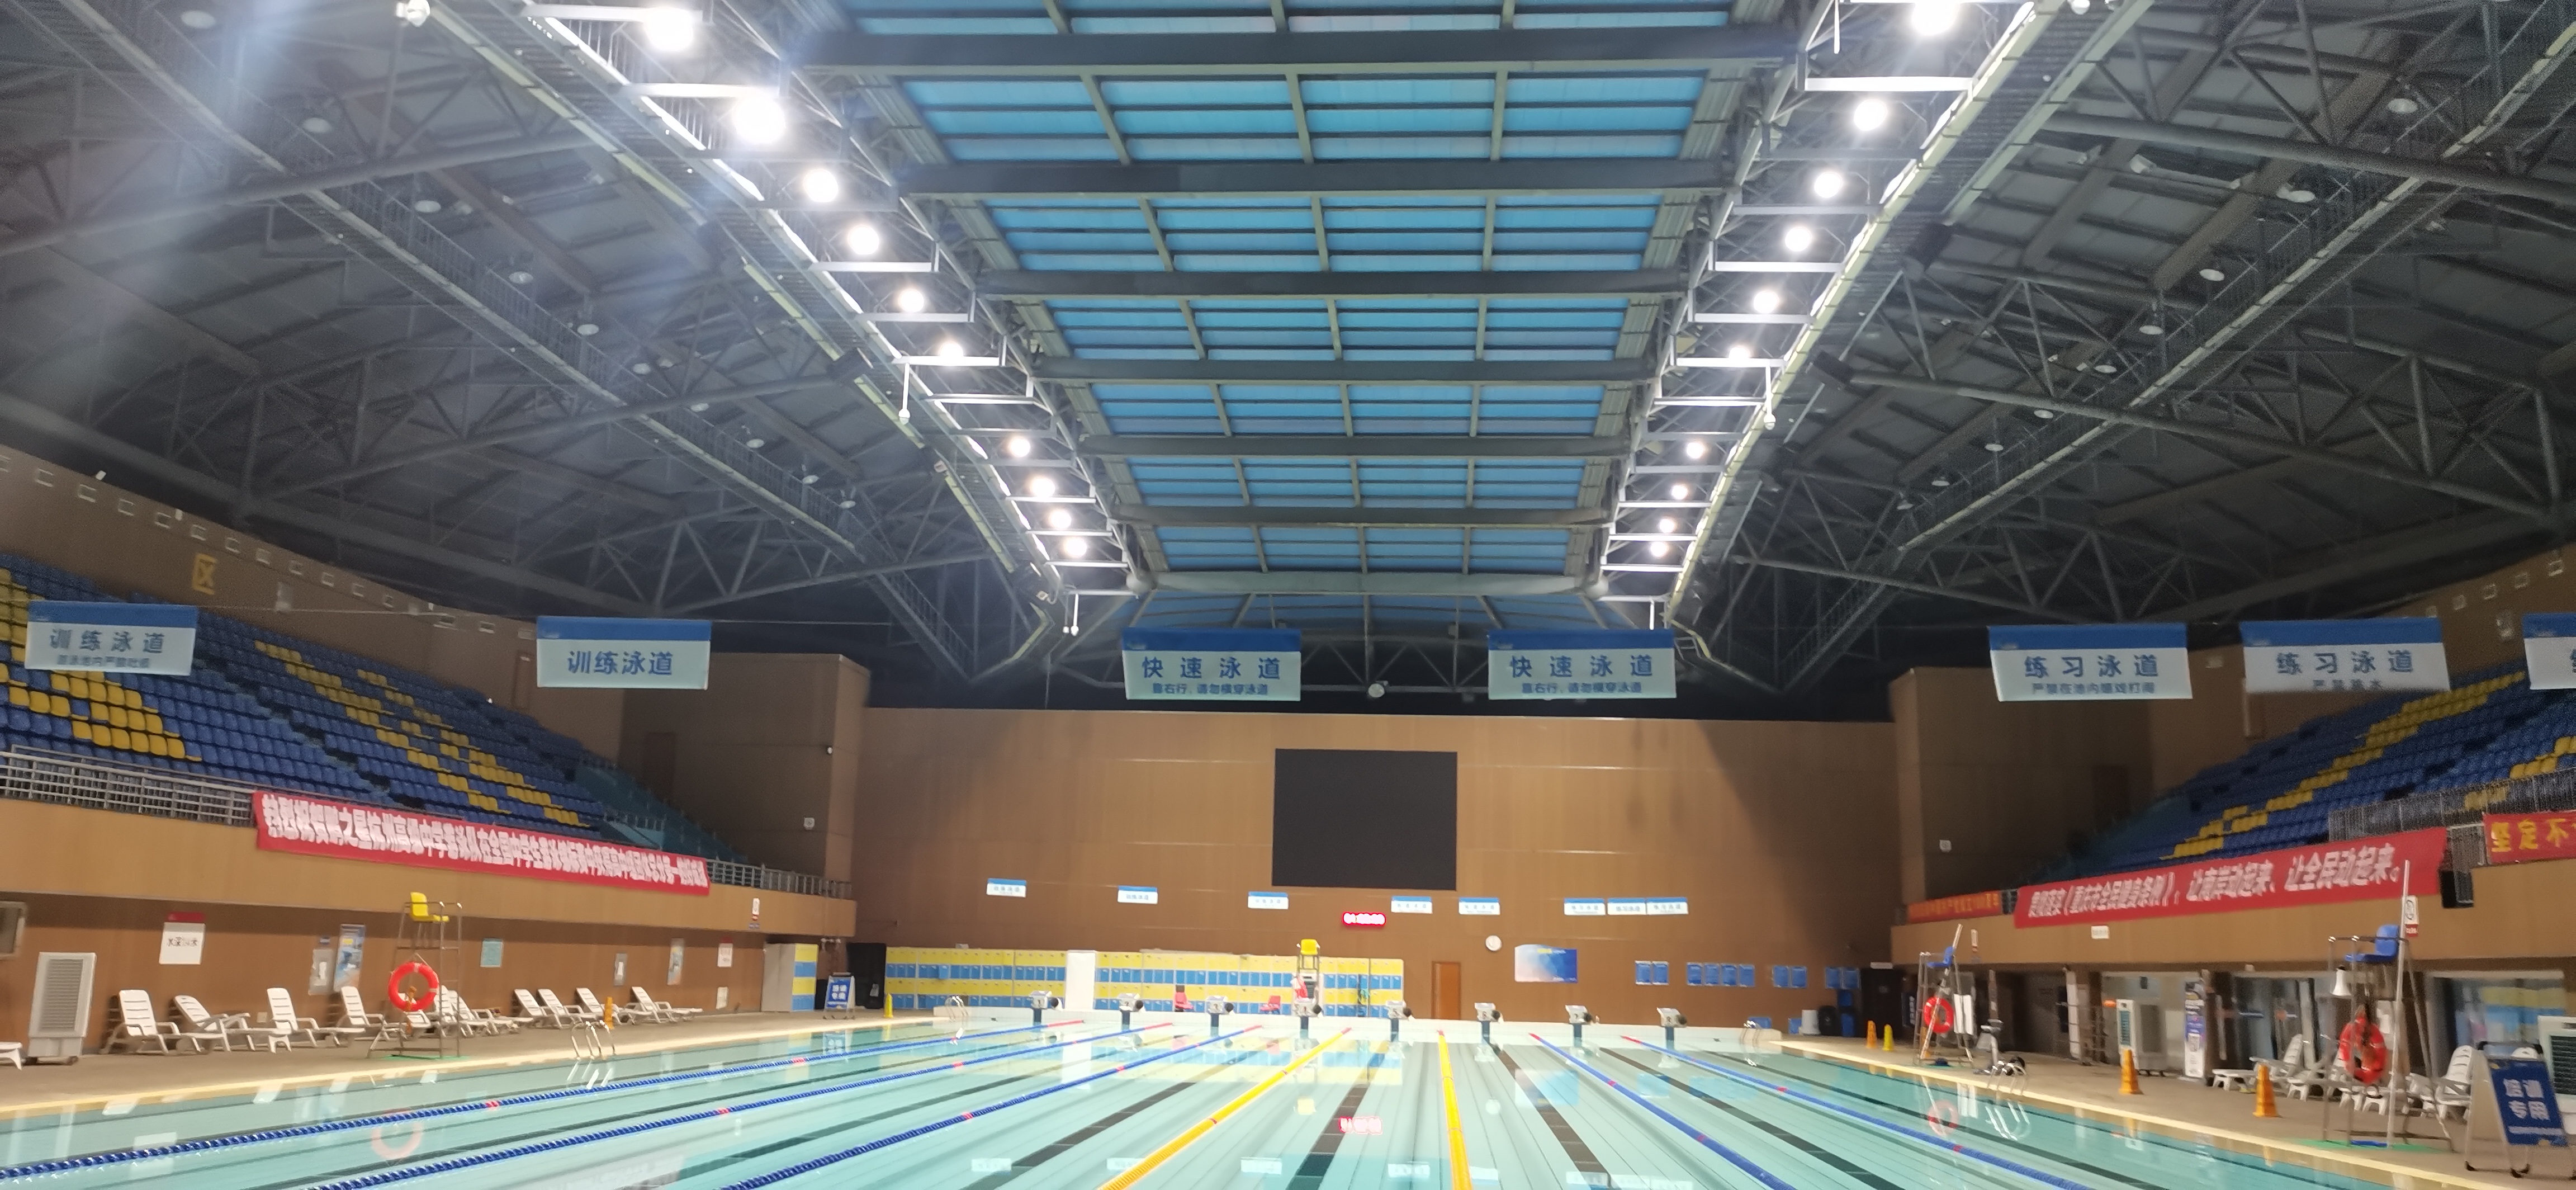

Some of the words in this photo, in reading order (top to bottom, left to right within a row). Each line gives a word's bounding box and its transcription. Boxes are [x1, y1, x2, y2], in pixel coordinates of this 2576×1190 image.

[50, 628, 164, 653] 训练泳道
[567, 650, 673, 675] 训练泳道
[1142, 657, 1280, 679] 快速泳道
[1509, 655, 1652, 677] 快速泳道
[2024, 654, 2158, 678] 练习泳道
[2276, 650, 2414, 675] 练习泳道
[2491, 818, 2576, 853] 坚定不
[2508, 1101, 2551, 1121] 专用
